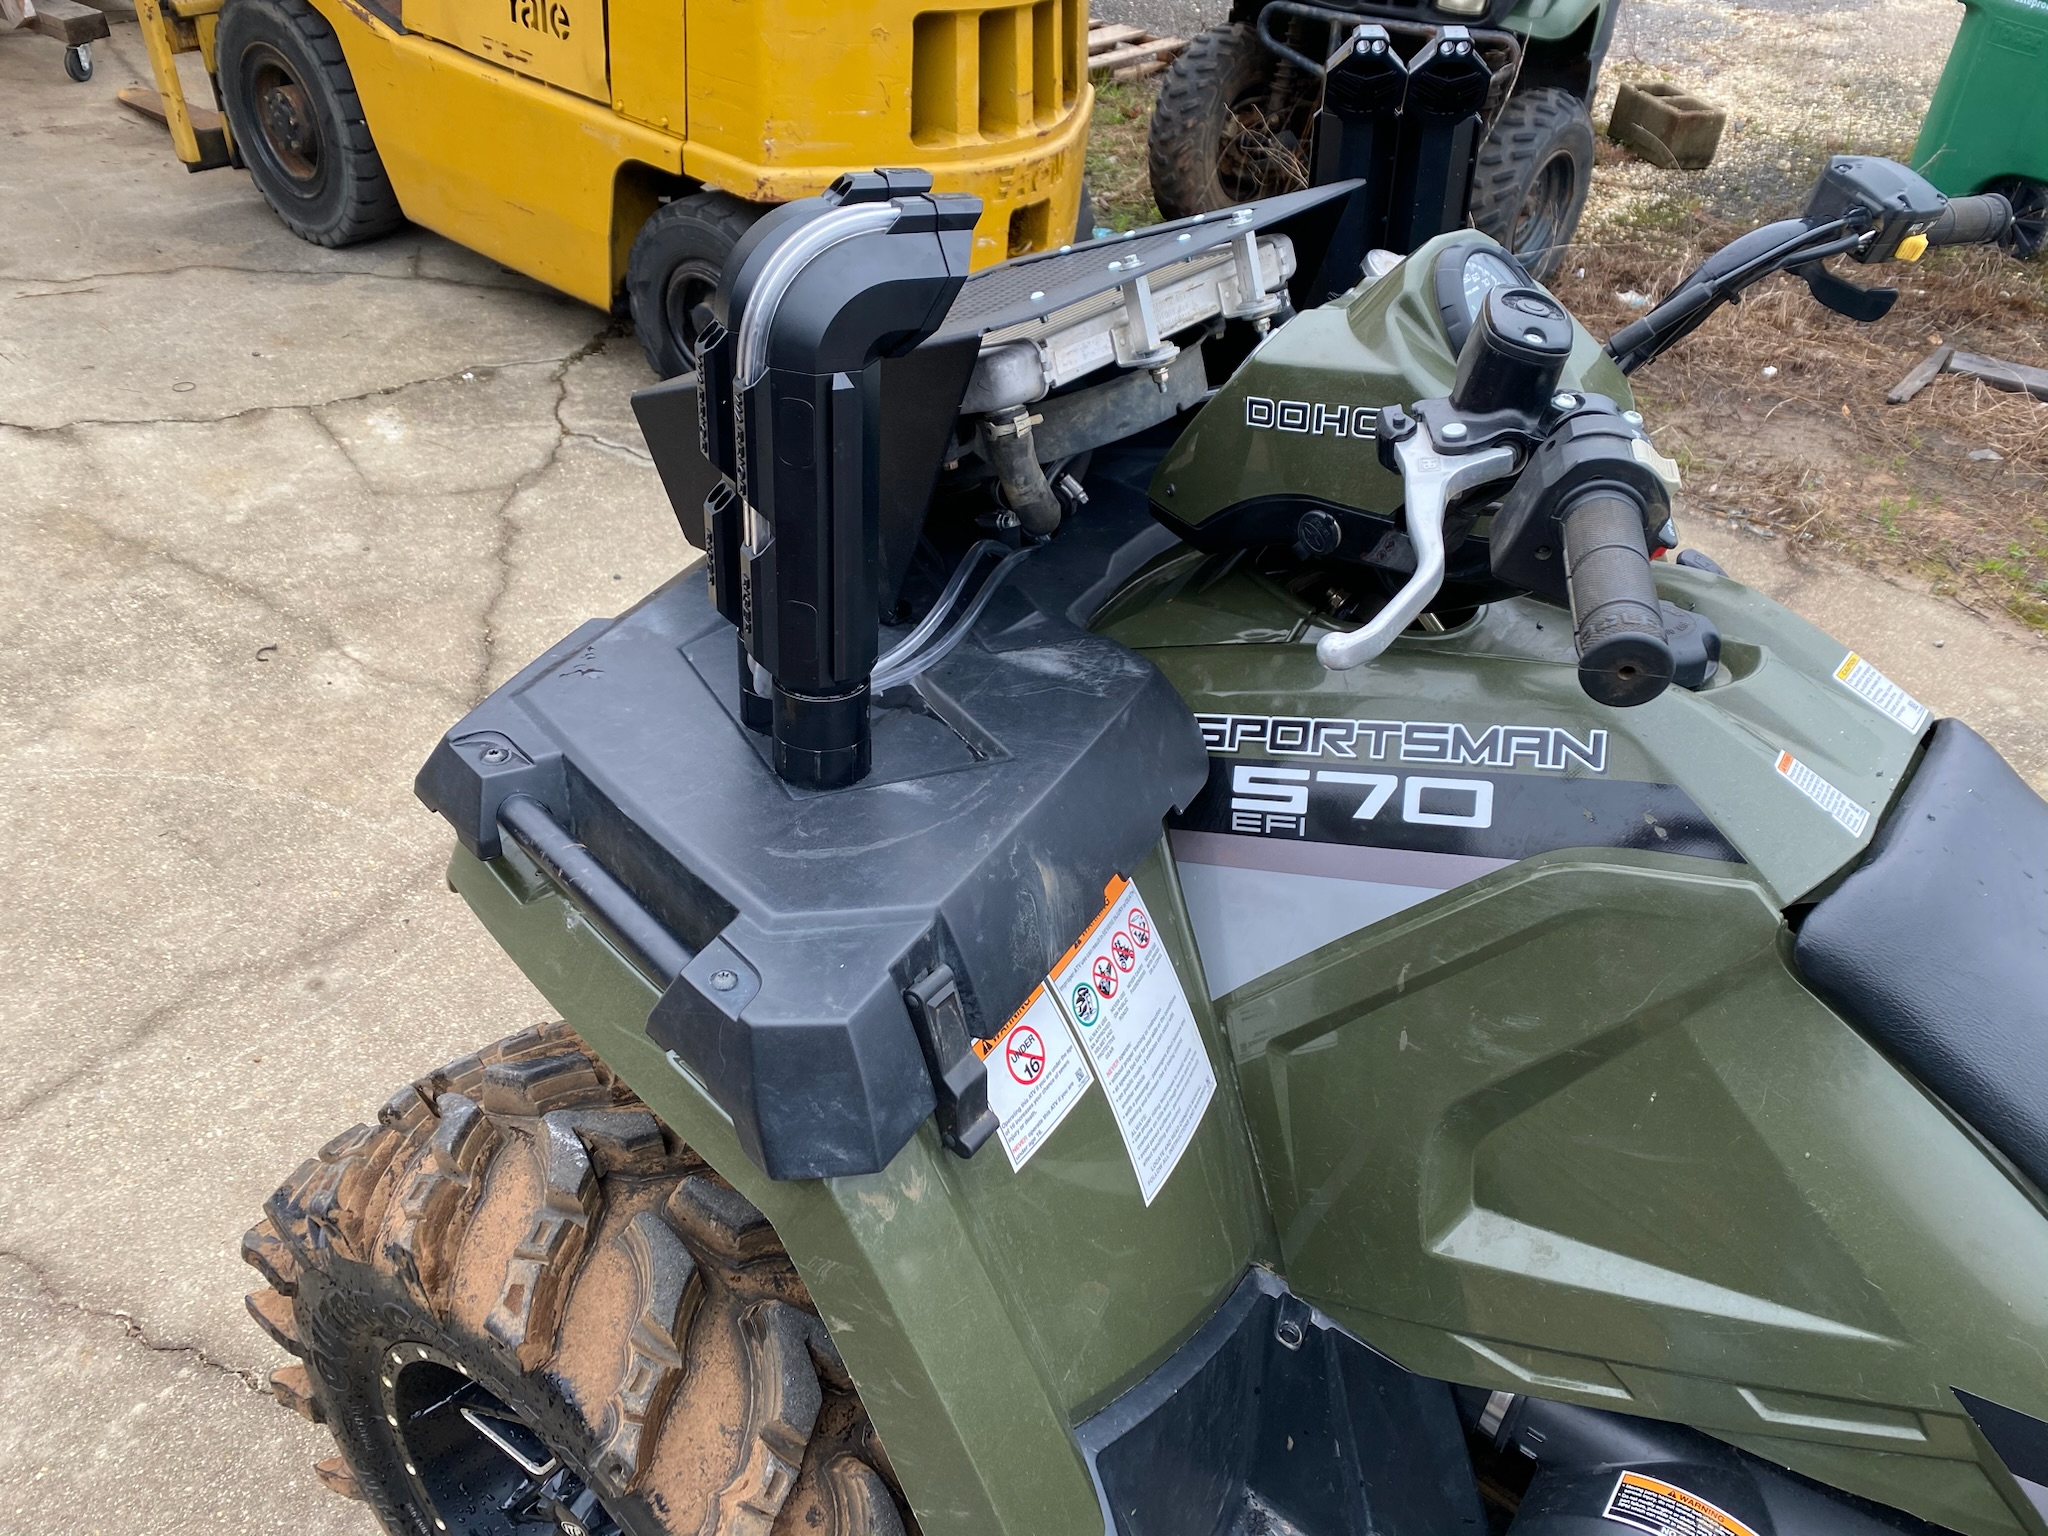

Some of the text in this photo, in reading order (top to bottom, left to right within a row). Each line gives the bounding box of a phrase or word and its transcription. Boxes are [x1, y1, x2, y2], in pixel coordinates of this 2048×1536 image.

[1246, 396, 1380, 439] DOHC
[1194, 713, 1608, 773] SPORTSMAN
[1231, 765, 1495, 829] 570
[1010, 1034, 1036, 1064] UNDER
[1024, 1057, 1040, 1079] 16
[1680, 1494, 1725, 1523] WARNING
